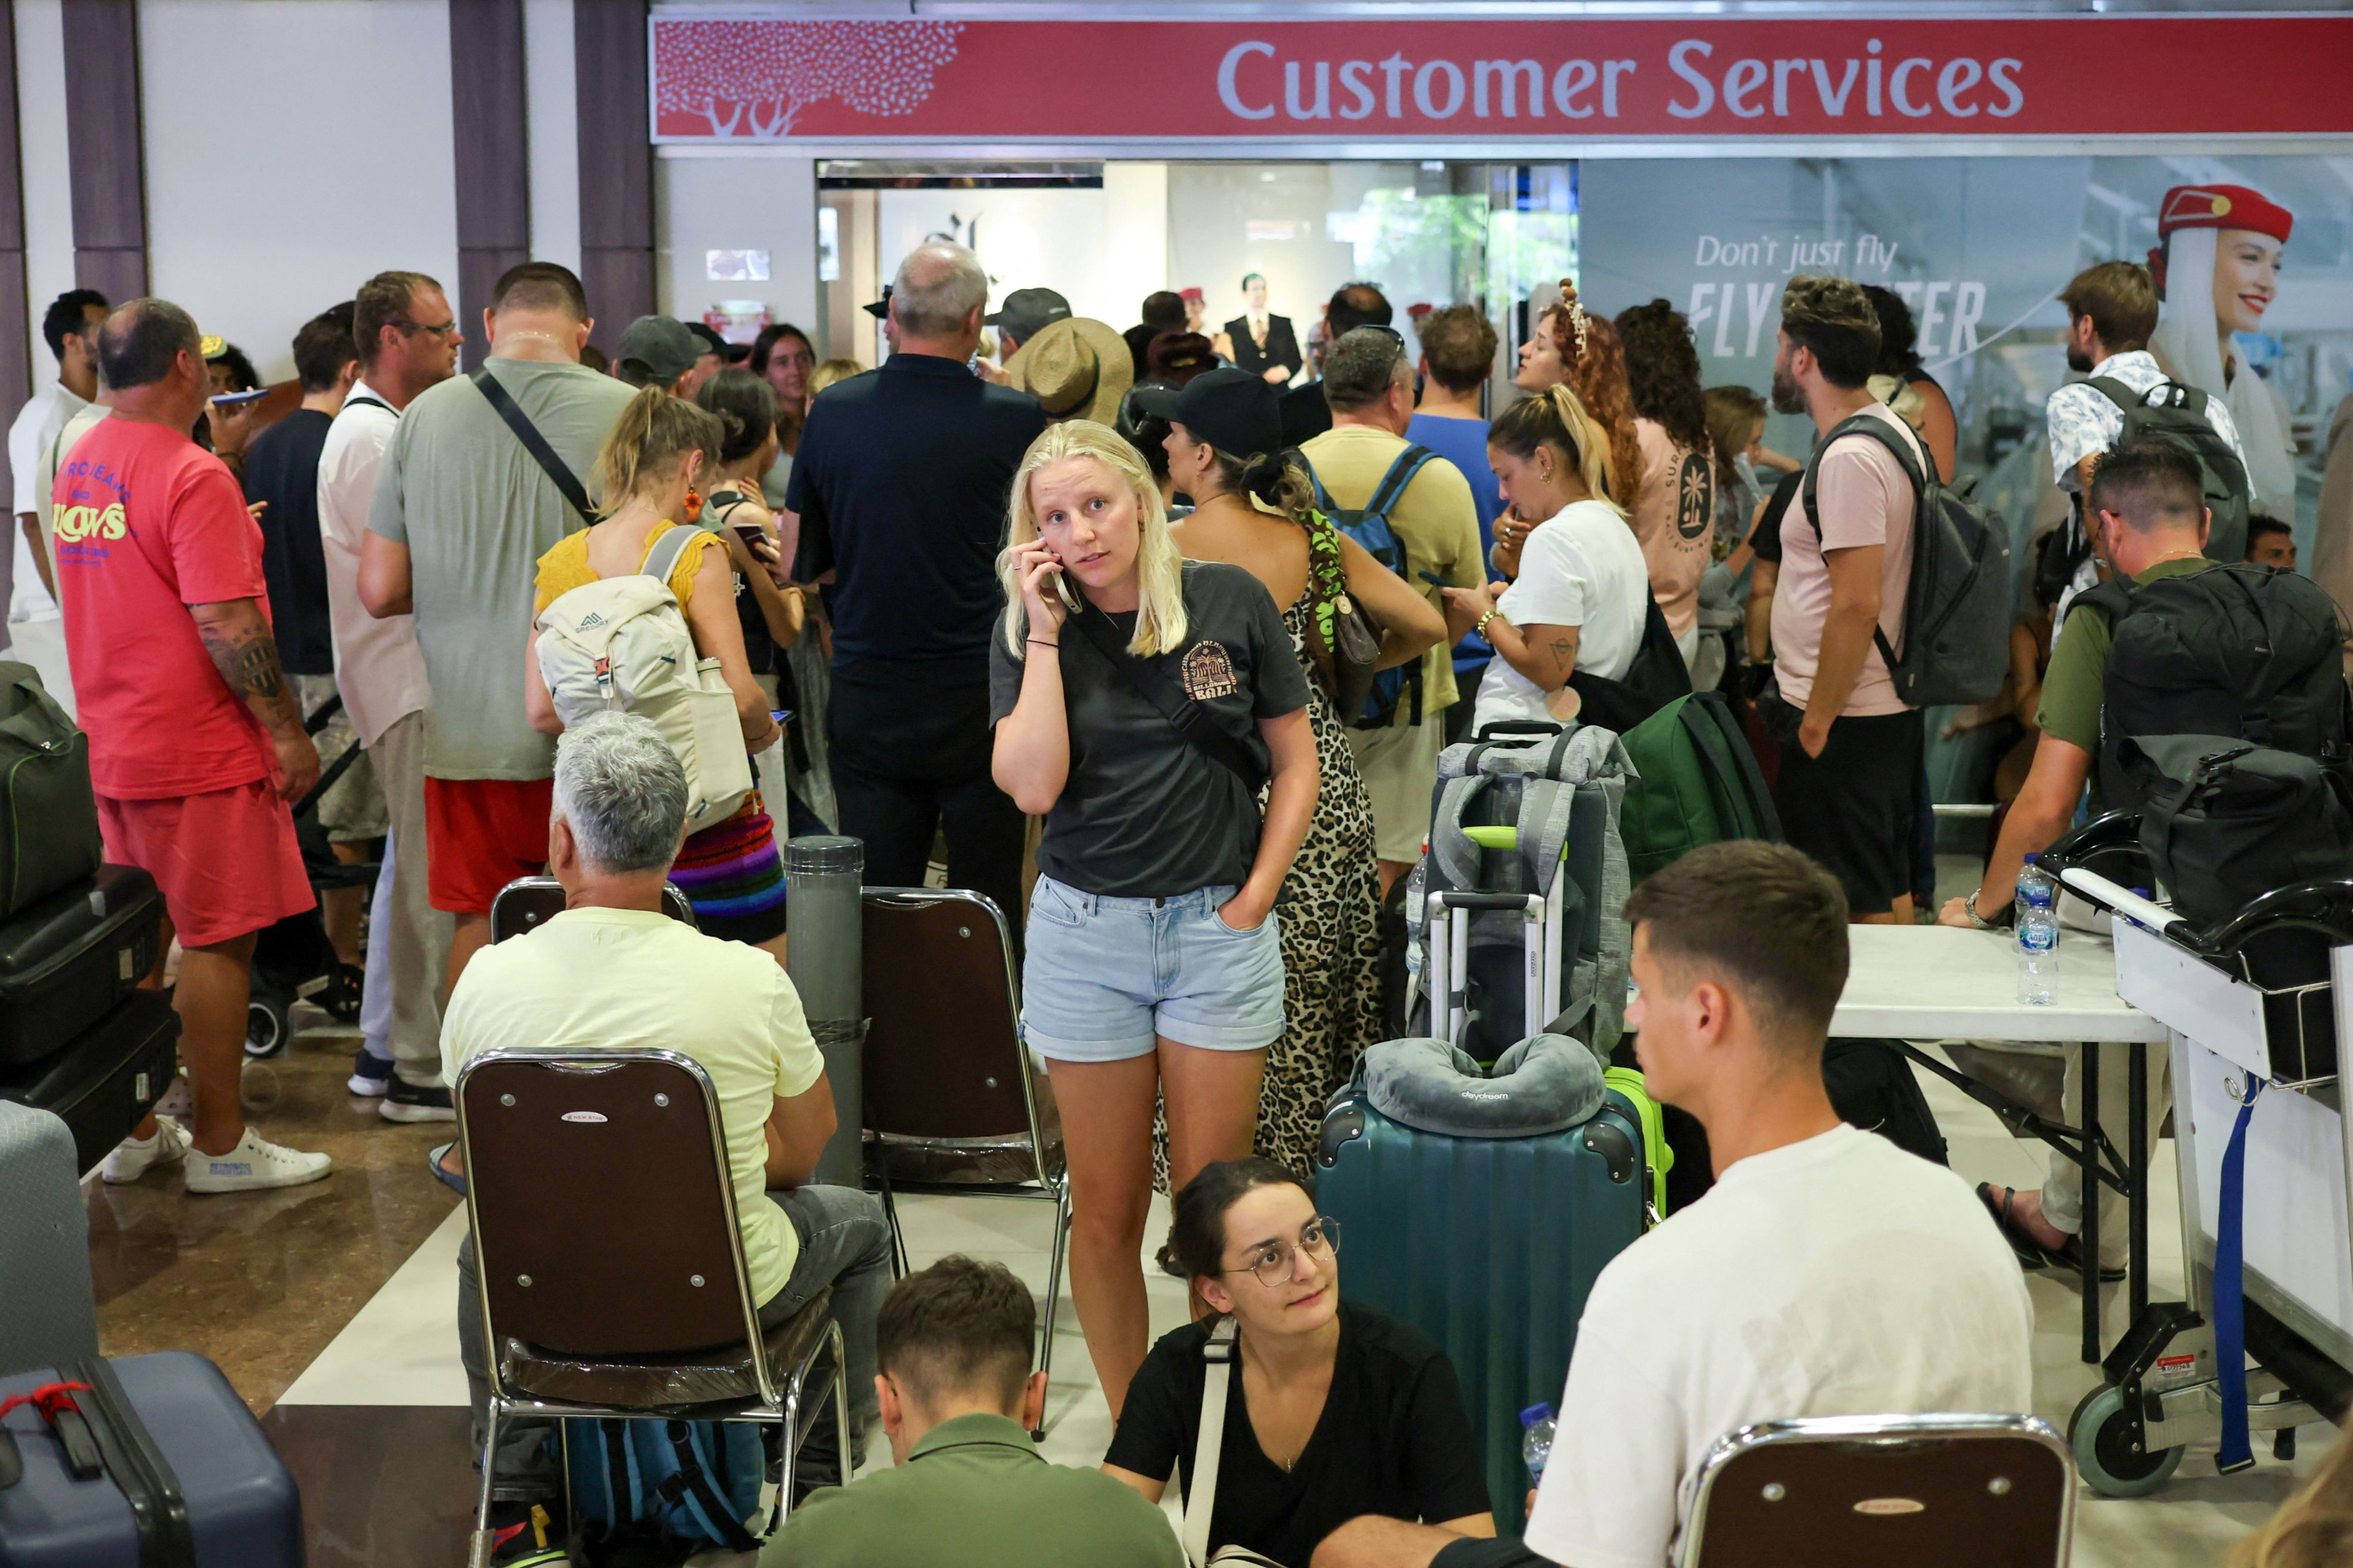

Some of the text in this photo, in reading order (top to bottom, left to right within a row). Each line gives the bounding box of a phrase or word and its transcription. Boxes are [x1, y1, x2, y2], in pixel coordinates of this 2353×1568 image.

[1217, 39, 2024, 120] Customer Services
[1696, 233, 1898, 274] Don't just fly
[1688, 282, 1775, 357] FLY
[576, 619, 608, 633] GREGORY
[1195, 685, 1232, 700] BALI
[2028, 933, 2047, 942] AQUA
[1461, 1090, 1508, 1101] daydream
